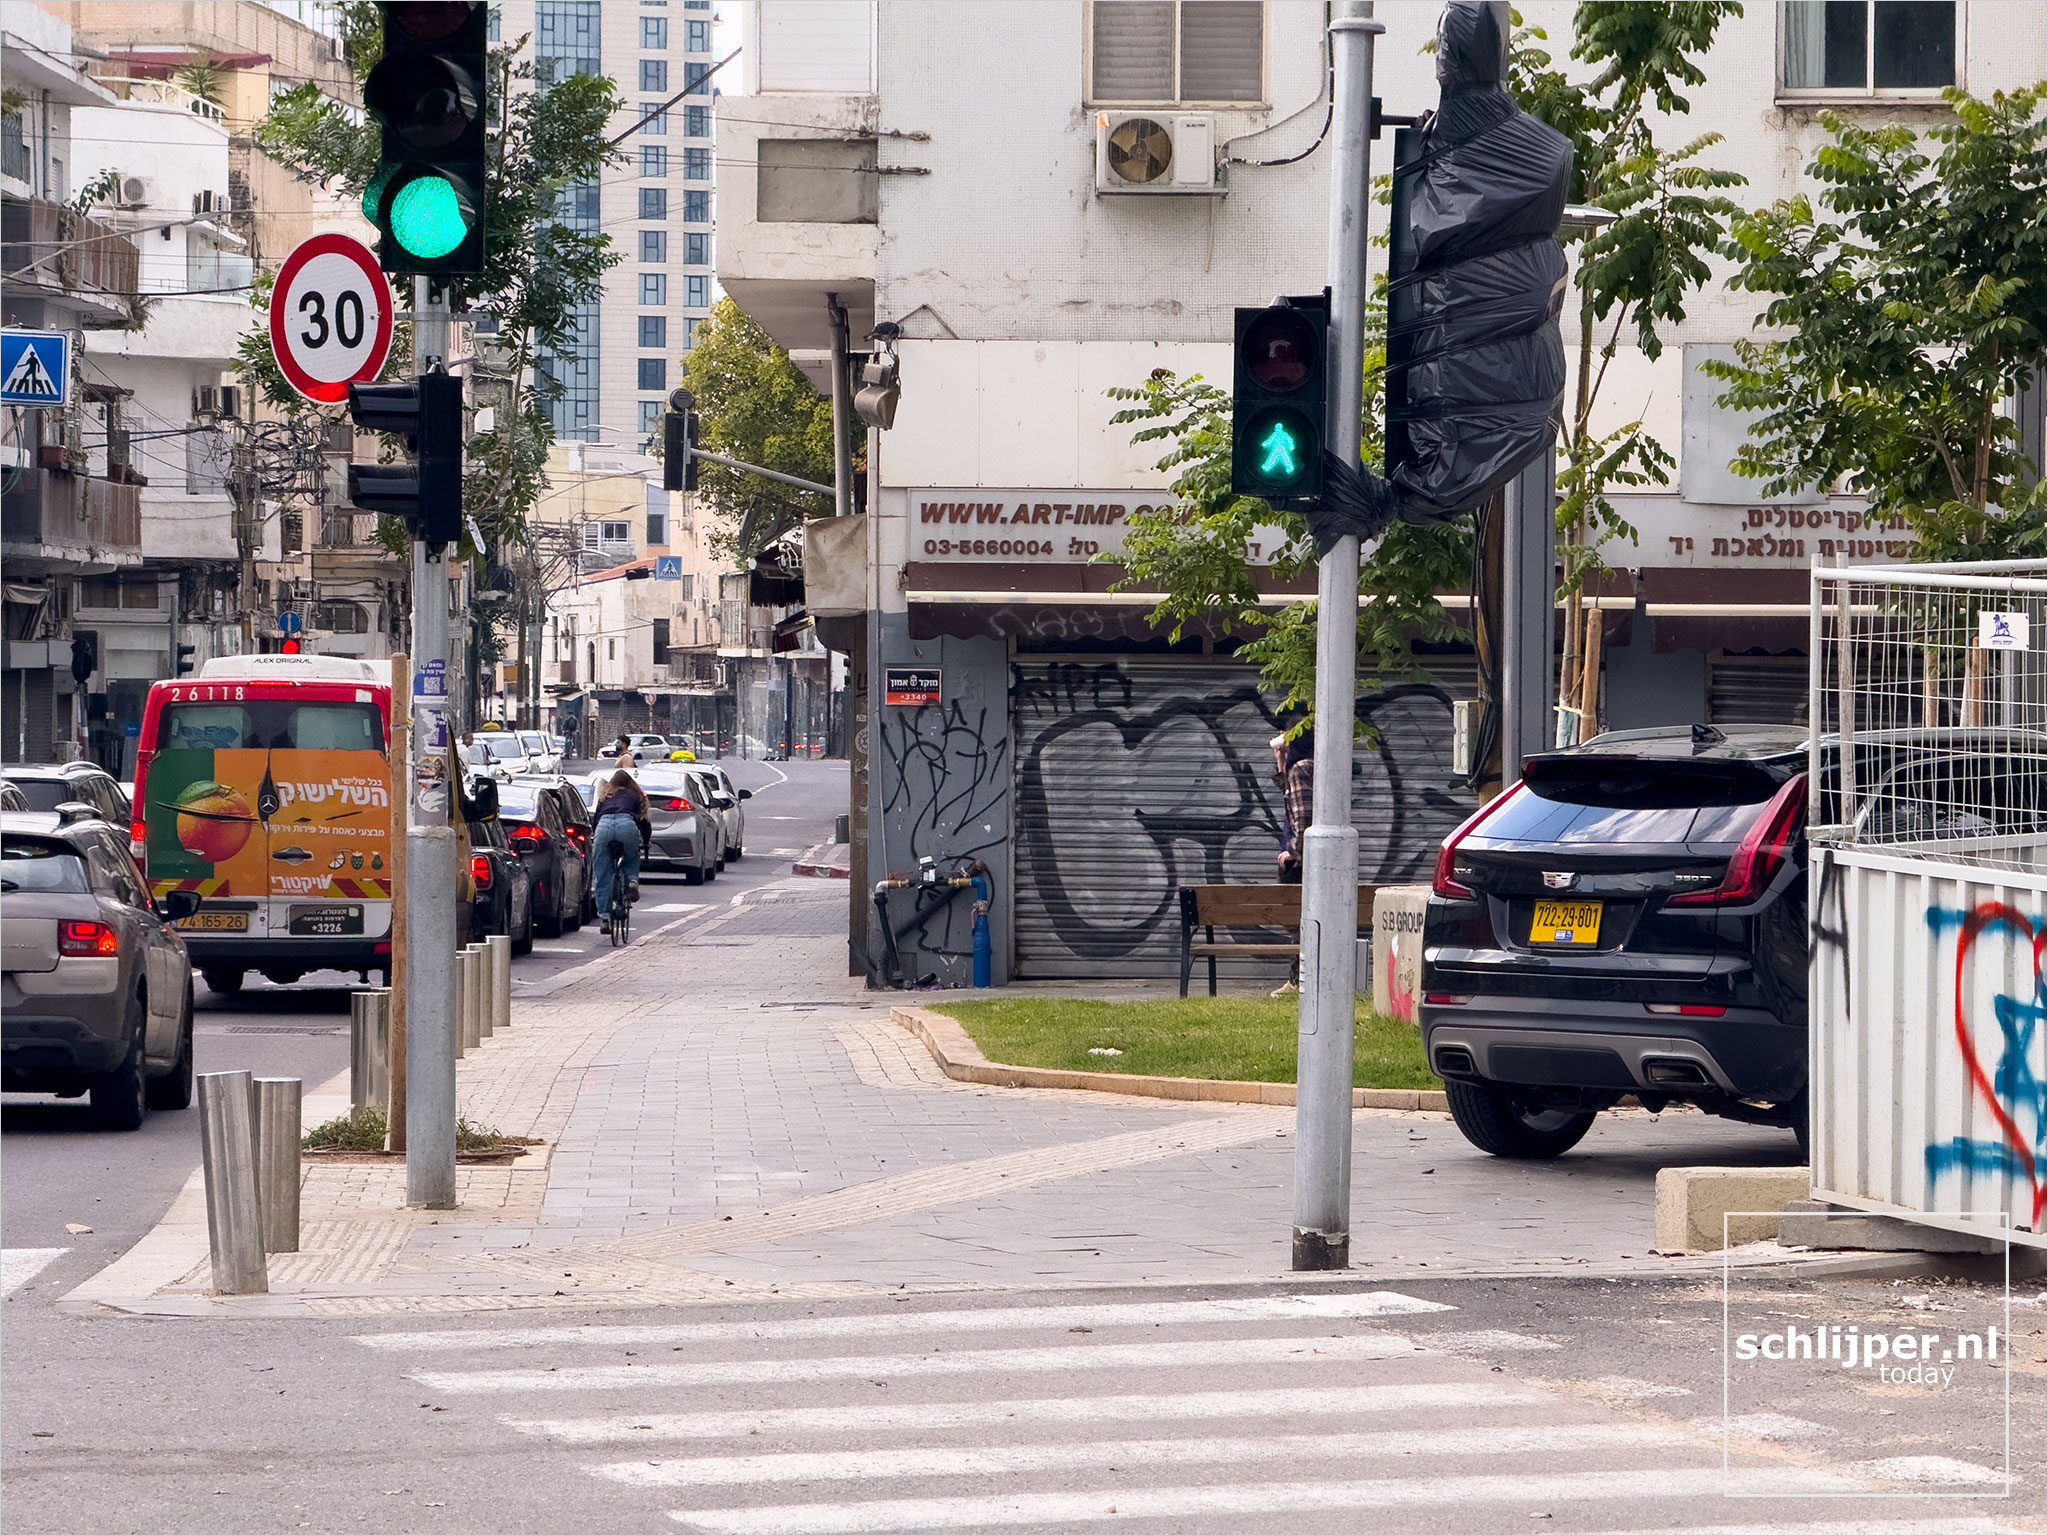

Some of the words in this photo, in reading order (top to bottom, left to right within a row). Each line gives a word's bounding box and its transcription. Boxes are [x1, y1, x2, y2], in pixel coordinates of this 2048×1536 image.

[299, 290, 364, 349] 30
[924, 539, 1053, 555] 03-5660004
[1669, 535, 1693, 556] יד
[1711, 533, 1805, 558] ומלאכת
[890, 679, 909, 688] אמון
[918, 679, 938, 688] מוקד
[341, 776, 366, 785] שלישי
[368, 777, 383, 786] בכל
[276, 779, 388, 807] השלישוק
[293, 825, 316, 834] פירות
[319, 825, 330, 834] על
[333, 827, 356, 836] כאסח
[358, 828, 385, 836] מבצעי
[1397, 912, 1424, 933] GROUP
